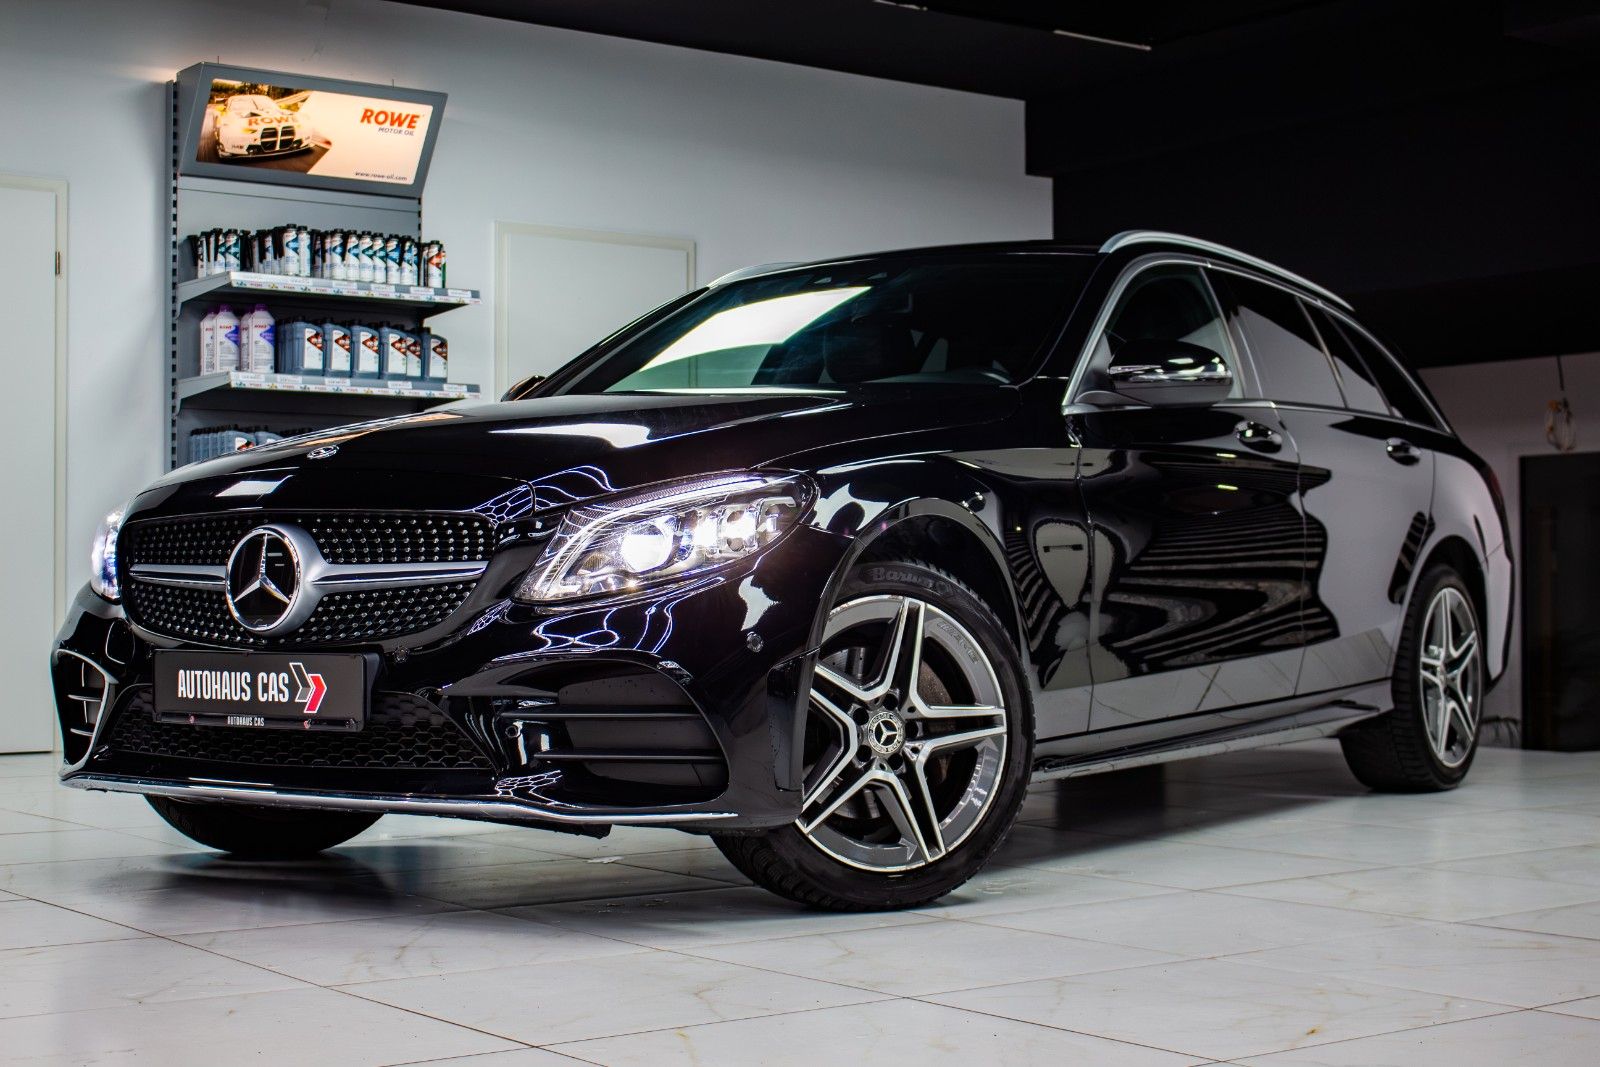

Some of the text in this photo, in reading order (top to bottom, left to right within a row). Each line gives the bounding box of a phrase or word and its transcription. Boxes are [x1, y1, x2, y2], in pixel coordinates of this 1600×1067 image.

[360, 108, 420, 129] ROWE
[378, 127, 403, 135] MOTOR
[355, 171, 408, 181] www.rowe-oil.com
[177, 669, 290, 703] AUTOHAUS CAS
[227, 715, 265, 727] AUTOHAUS CAS
